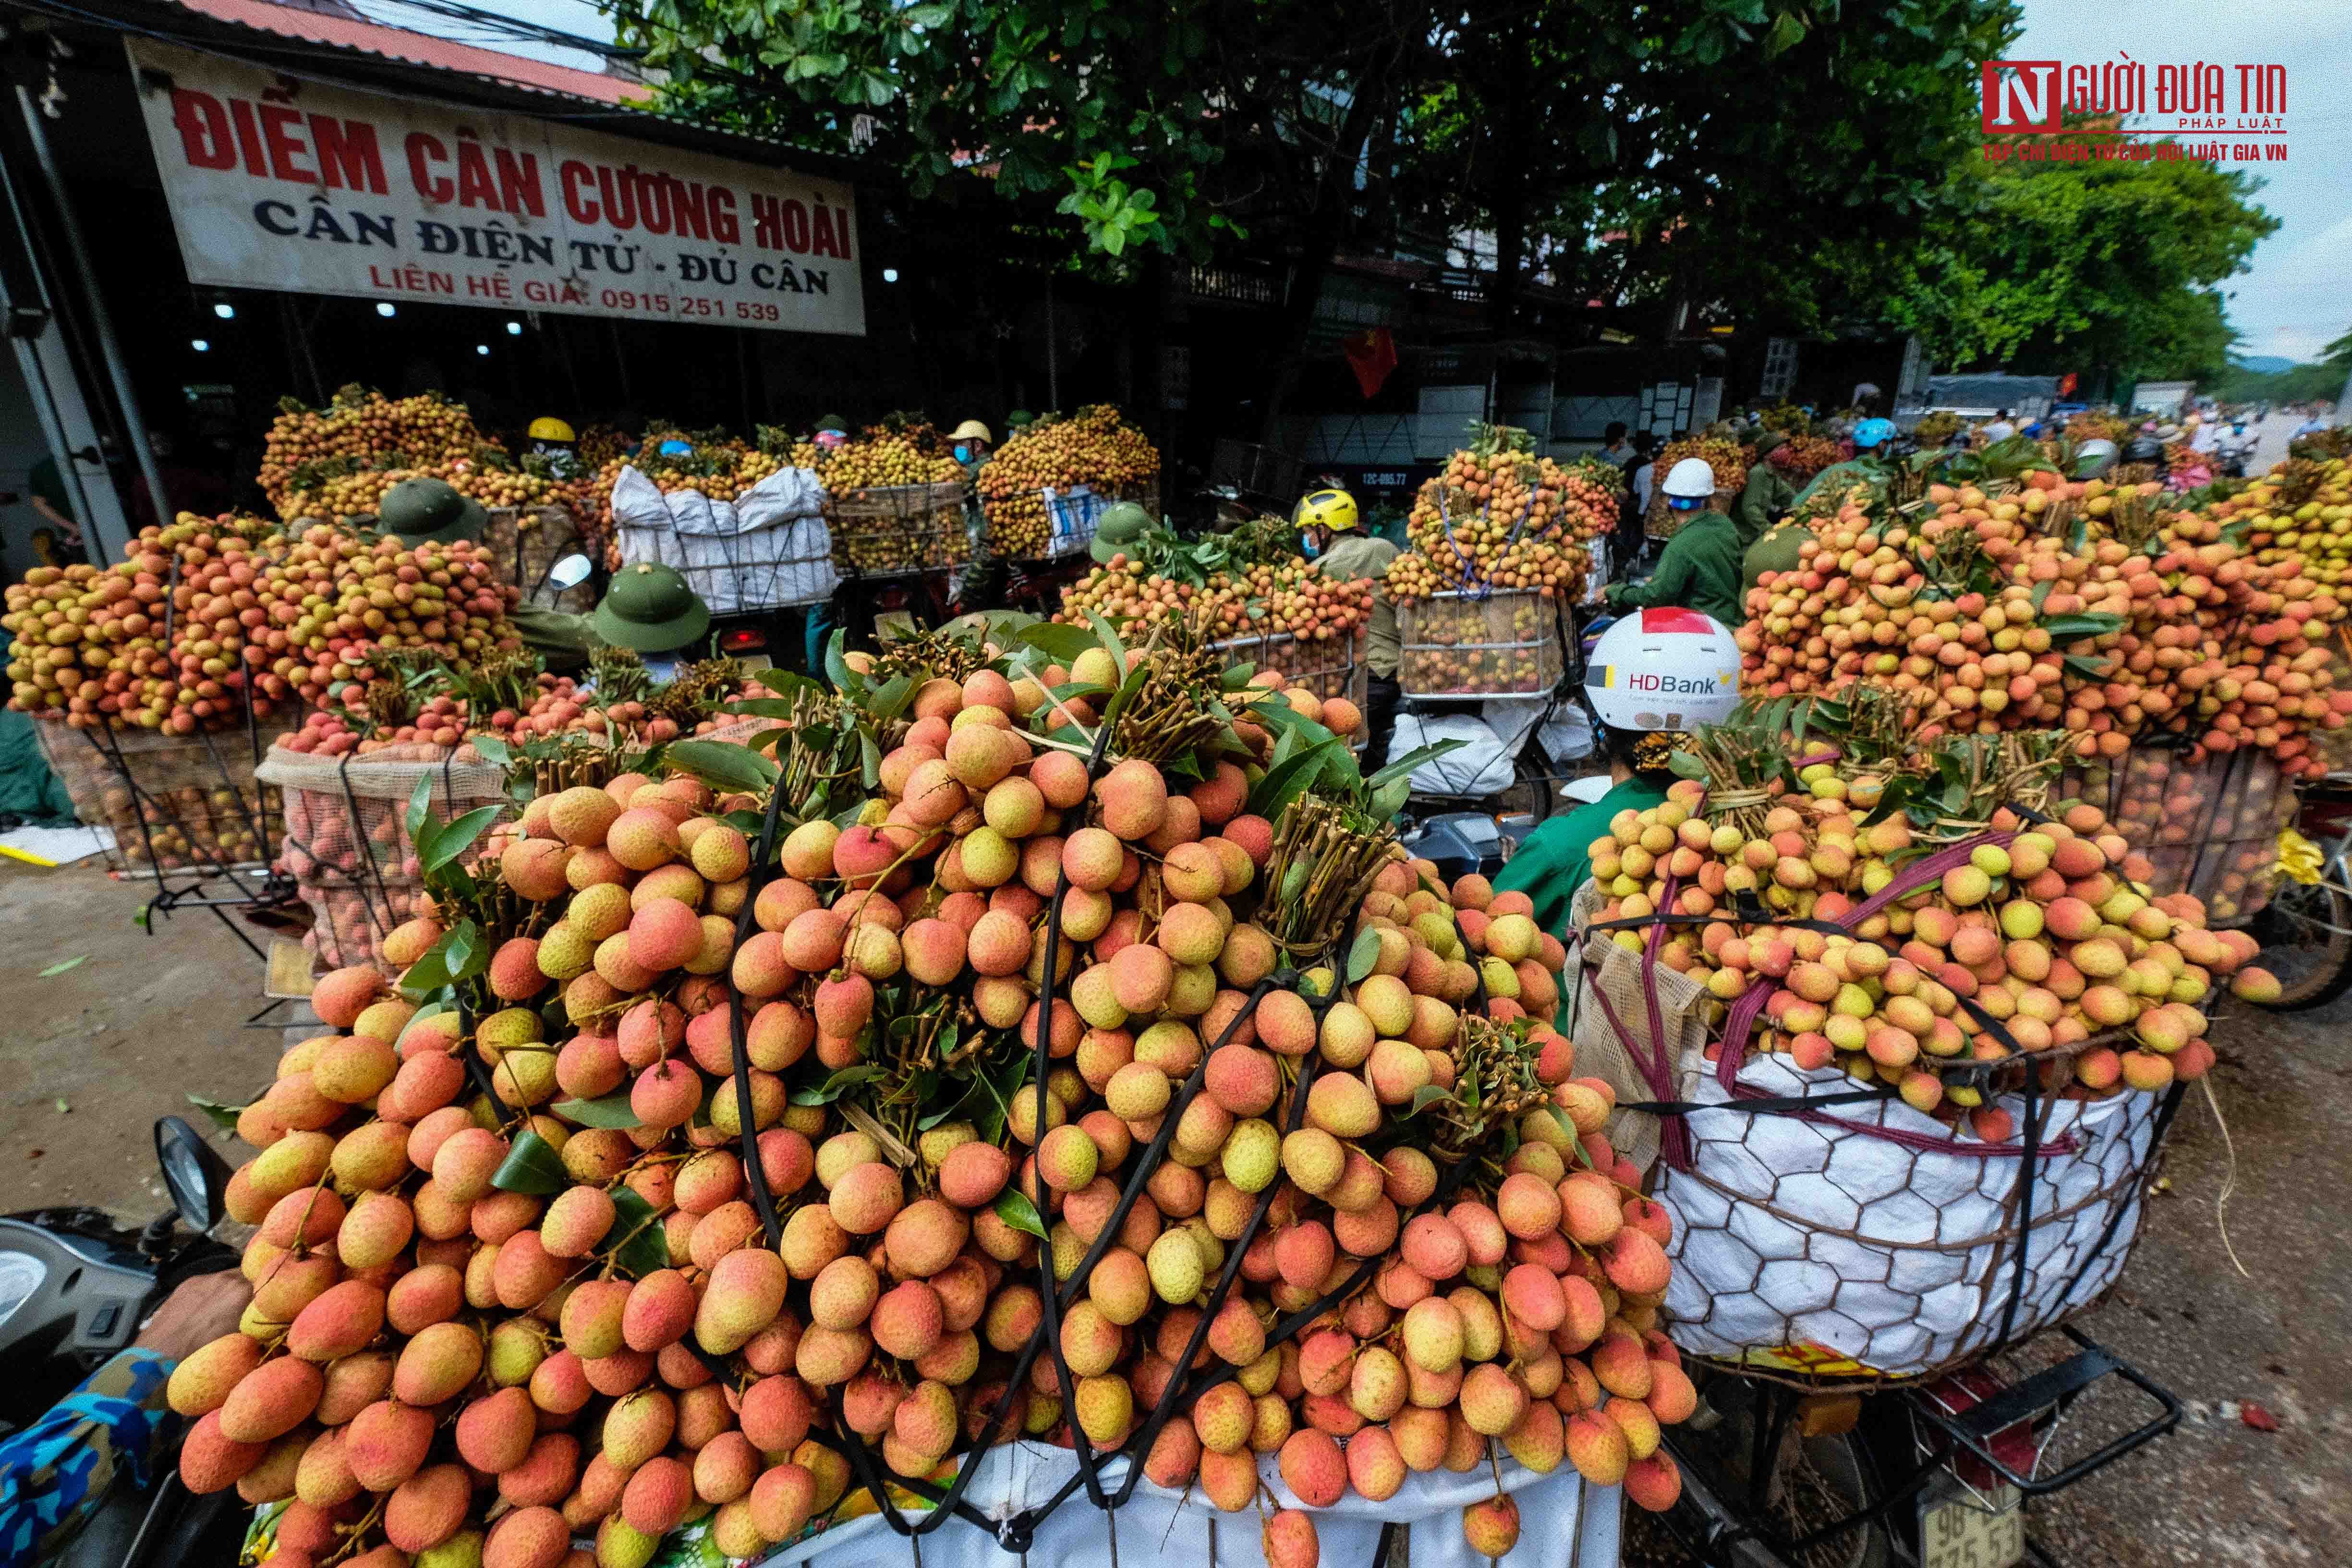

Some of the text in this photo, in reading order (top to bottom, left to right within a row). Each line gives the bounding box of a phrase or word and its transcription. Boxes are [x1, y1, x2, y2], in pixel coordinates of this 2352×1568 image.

[170, 73, 853, 261] ĐIỂM CÂN CƯƠNG HOÀI
[254, 195, 397, 249] CÂN
[416, 219, 555, 268] ĐIỆN
[570, 233, 641, 274] TỬ
[678, 247, 738, 286] ĐỦ
[750, 258, 829, 296] CÂN
[368, 263, 455, 294] LIÊN
[466, 268, 514, 306] HỆ
[601, 289, 670, 313] 0915
[679, 296, 725, 316] 251
[736, 303, 781, 322] 539
[1628, 673, 1716, 694] HDBank
